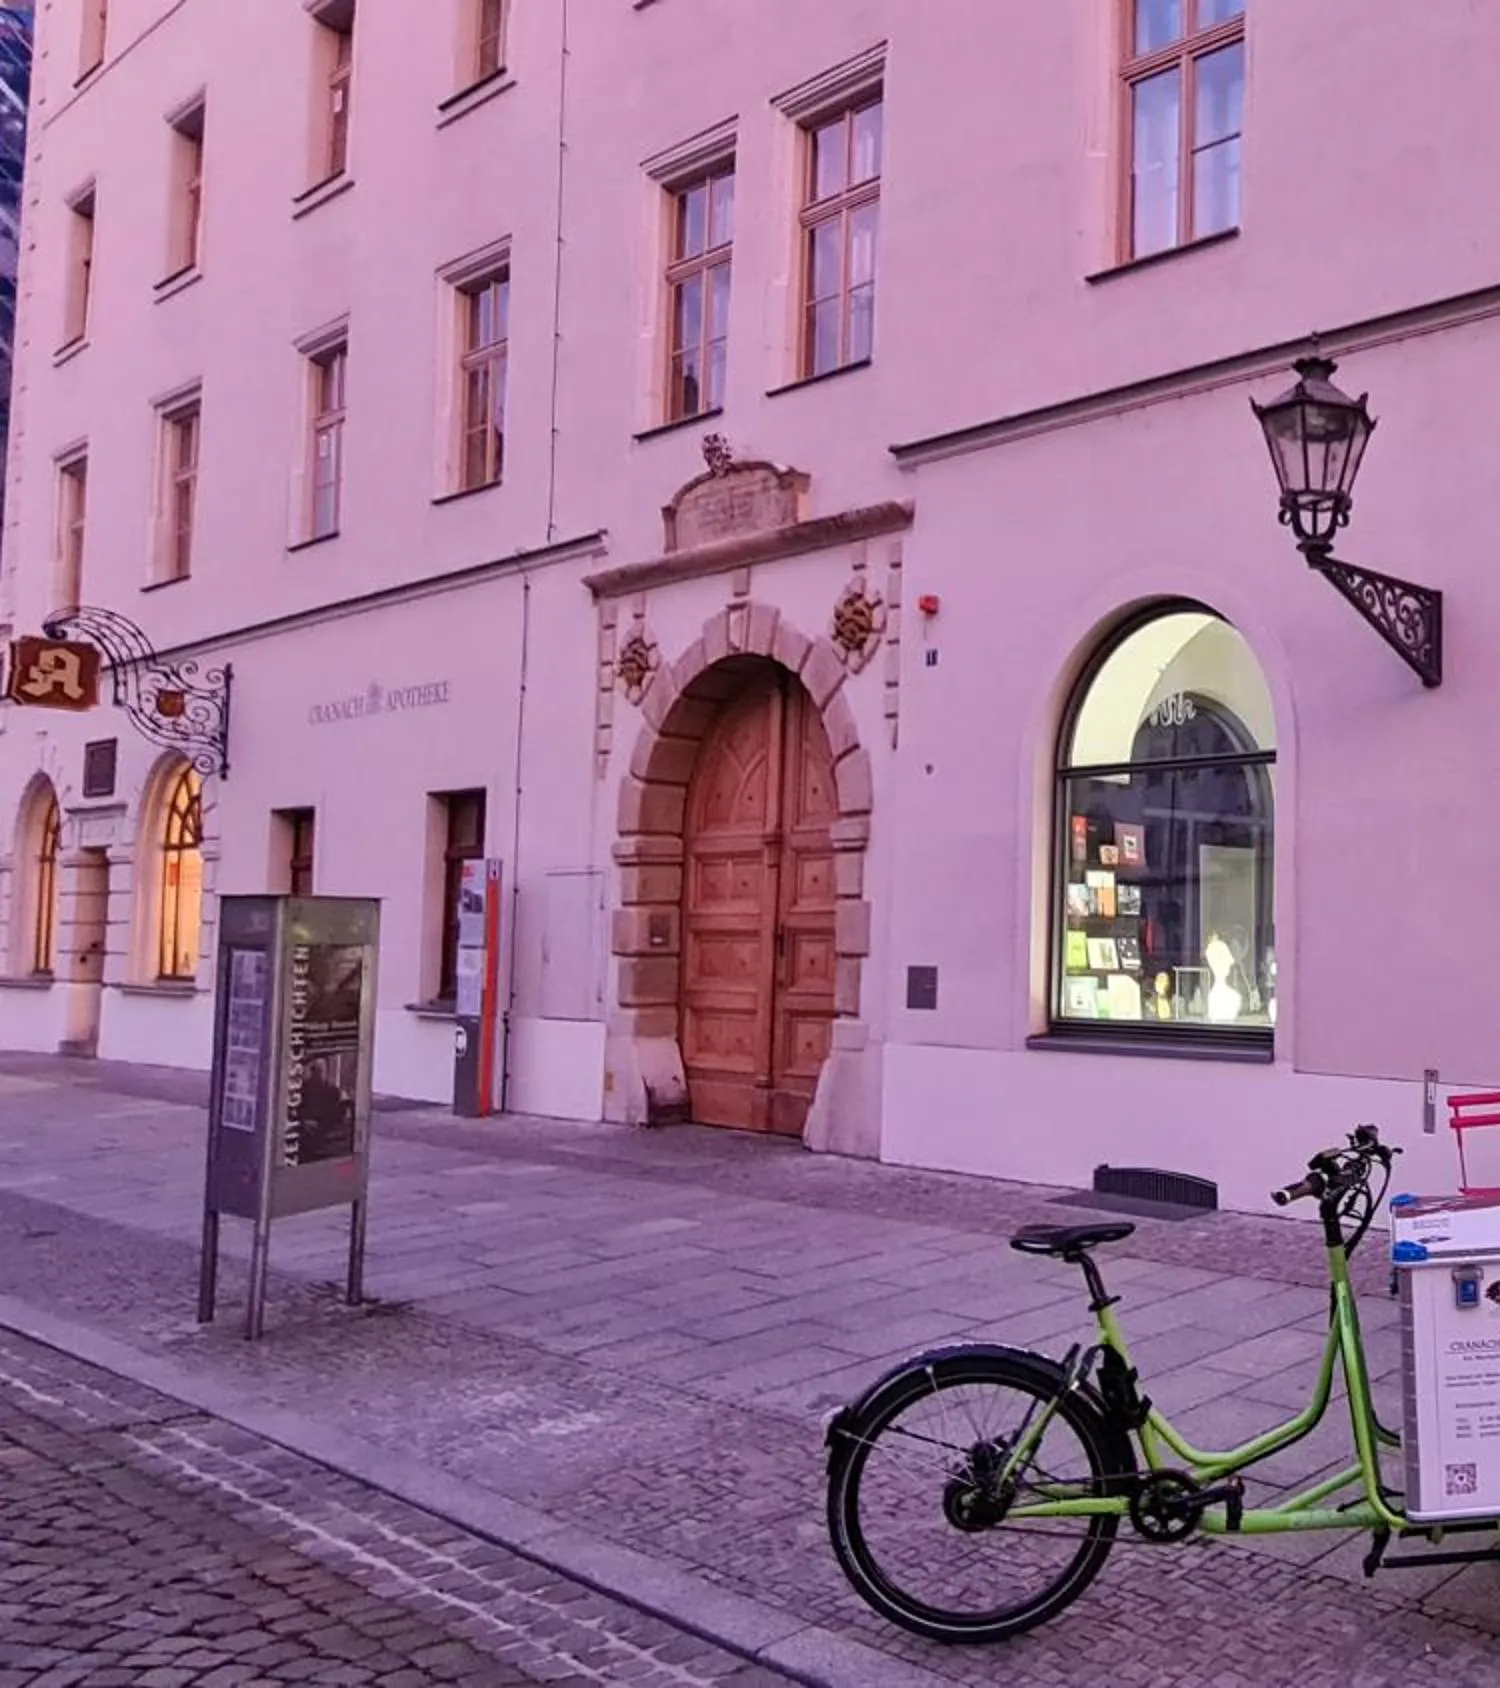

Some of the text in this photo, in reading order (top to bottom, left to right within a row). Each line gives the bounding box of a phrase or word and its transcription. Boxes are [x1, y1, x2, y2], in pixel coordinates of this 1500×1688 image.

[20, 648, 85, 699] A
[386, 680, 449, 712] APOTHEKE
[284, 946, 310, 1168] ZEIT-GESCHICHTEN
